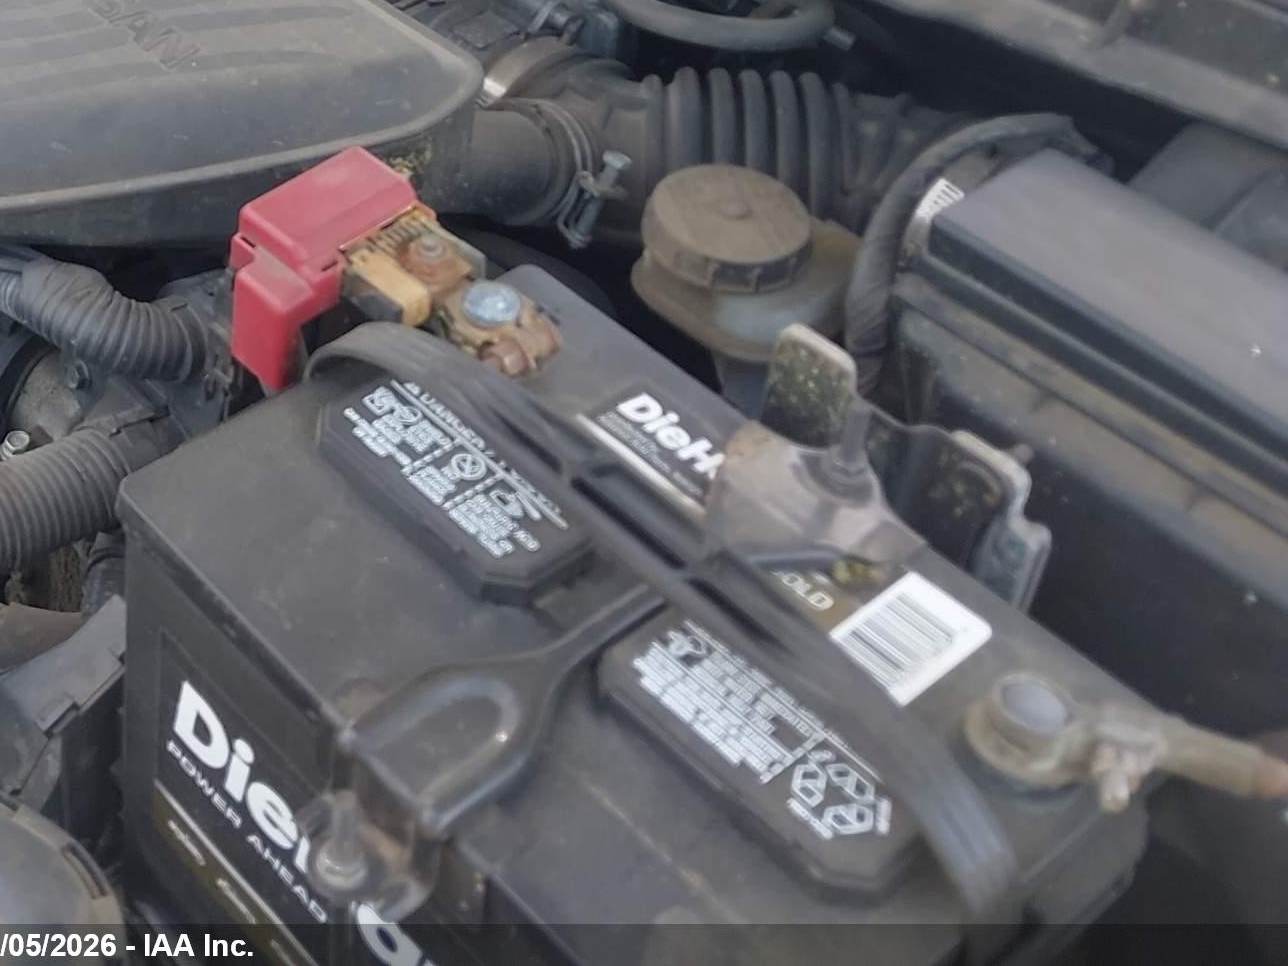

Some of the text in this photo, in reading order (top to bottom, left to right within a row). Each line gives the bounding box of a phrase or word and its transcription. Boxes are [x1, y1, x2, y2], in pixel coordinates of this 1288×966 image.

[616, 392, 727, 480] DieH
[770, 569, 835, 612] OLD
[166, 740, 242, 829] POWER
[246, 834, 327, 923] AHEAD
